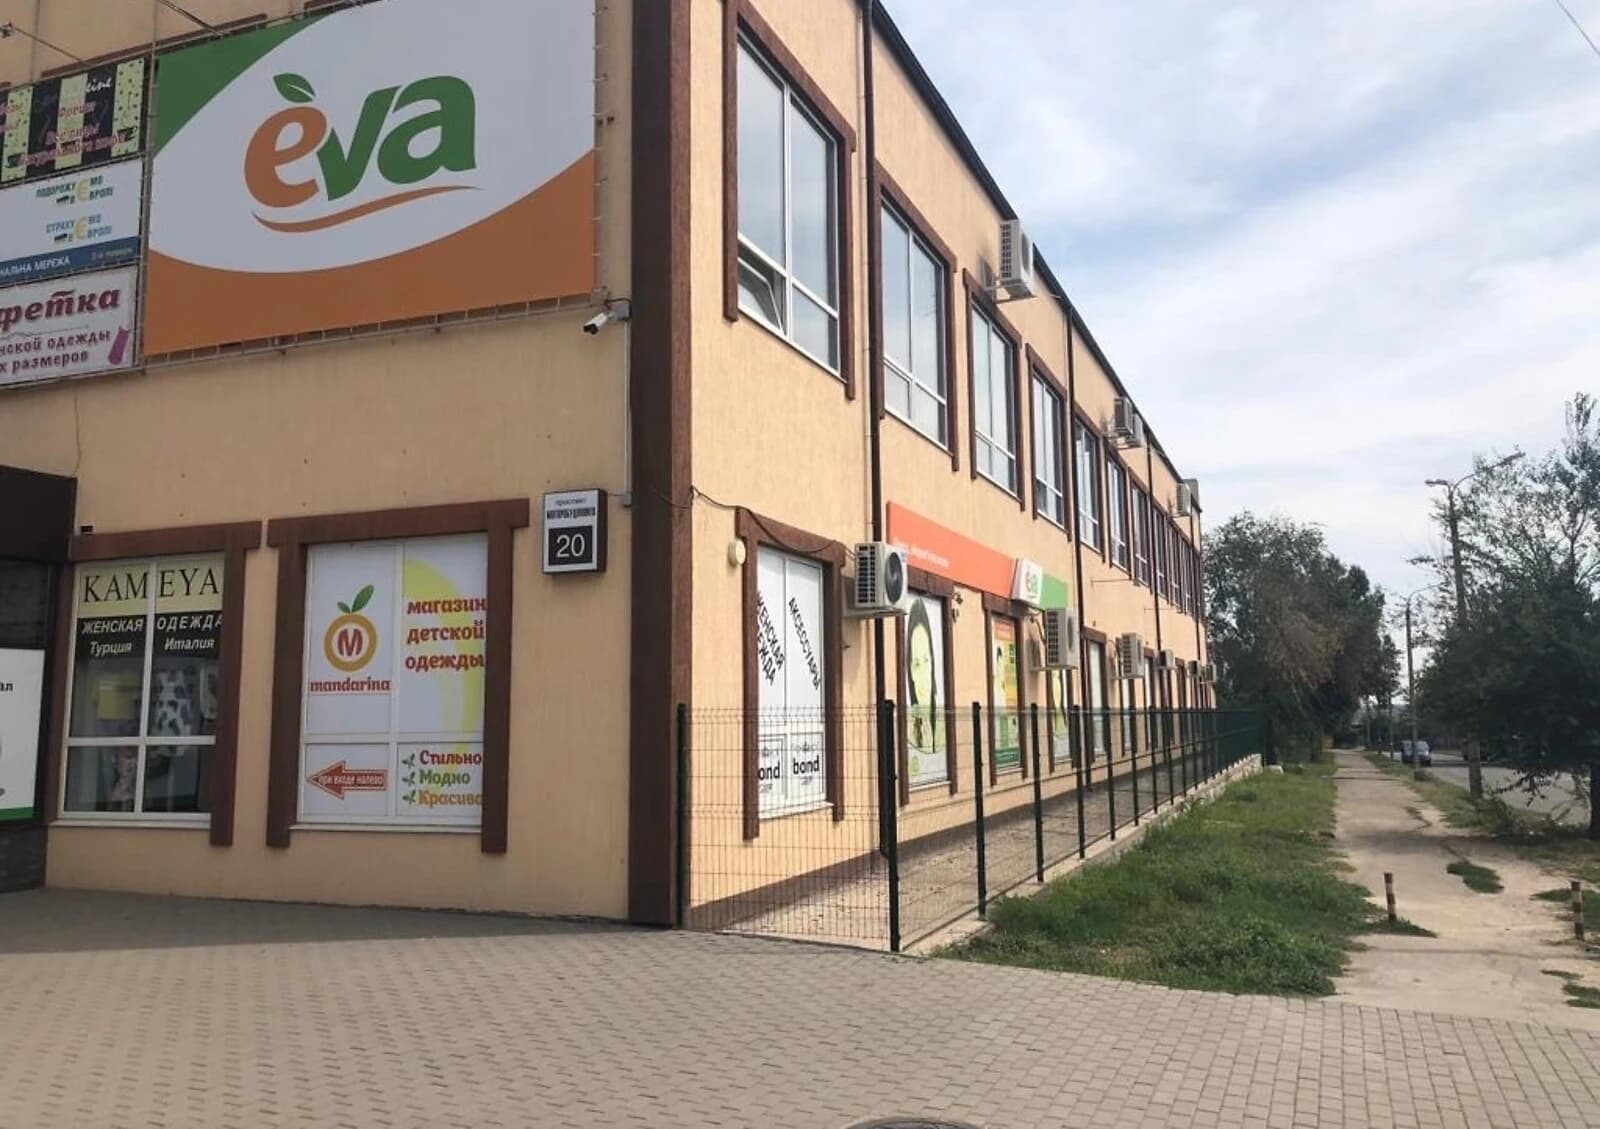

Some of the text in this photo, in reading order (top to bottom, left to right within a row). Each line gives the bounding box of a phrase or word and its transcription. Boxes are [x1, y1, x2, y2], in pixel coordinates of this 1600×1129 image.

[243, 75, 477, 208] eva
[47, 330, 110, 350] одежды
[12, 351, 88, 375] размеров
[556, 533, 585, 558] 20
[84, 568, 219, 603] KAMEYA
[407, 597, 487, 615] магазин
[82, 618, 144, 634] ЖЕНСКАЯ
[407, 619, 484, 645] детской
[90, 637, 215, 657] Турция Италия
[405, 653, 485, 673] одежды
[310, 677, 391, 693] mandarina
[420, 750, 482, 765] Стильно
[793, 755, 820, 775] bond
[418, 769, 471, 787] Модно
